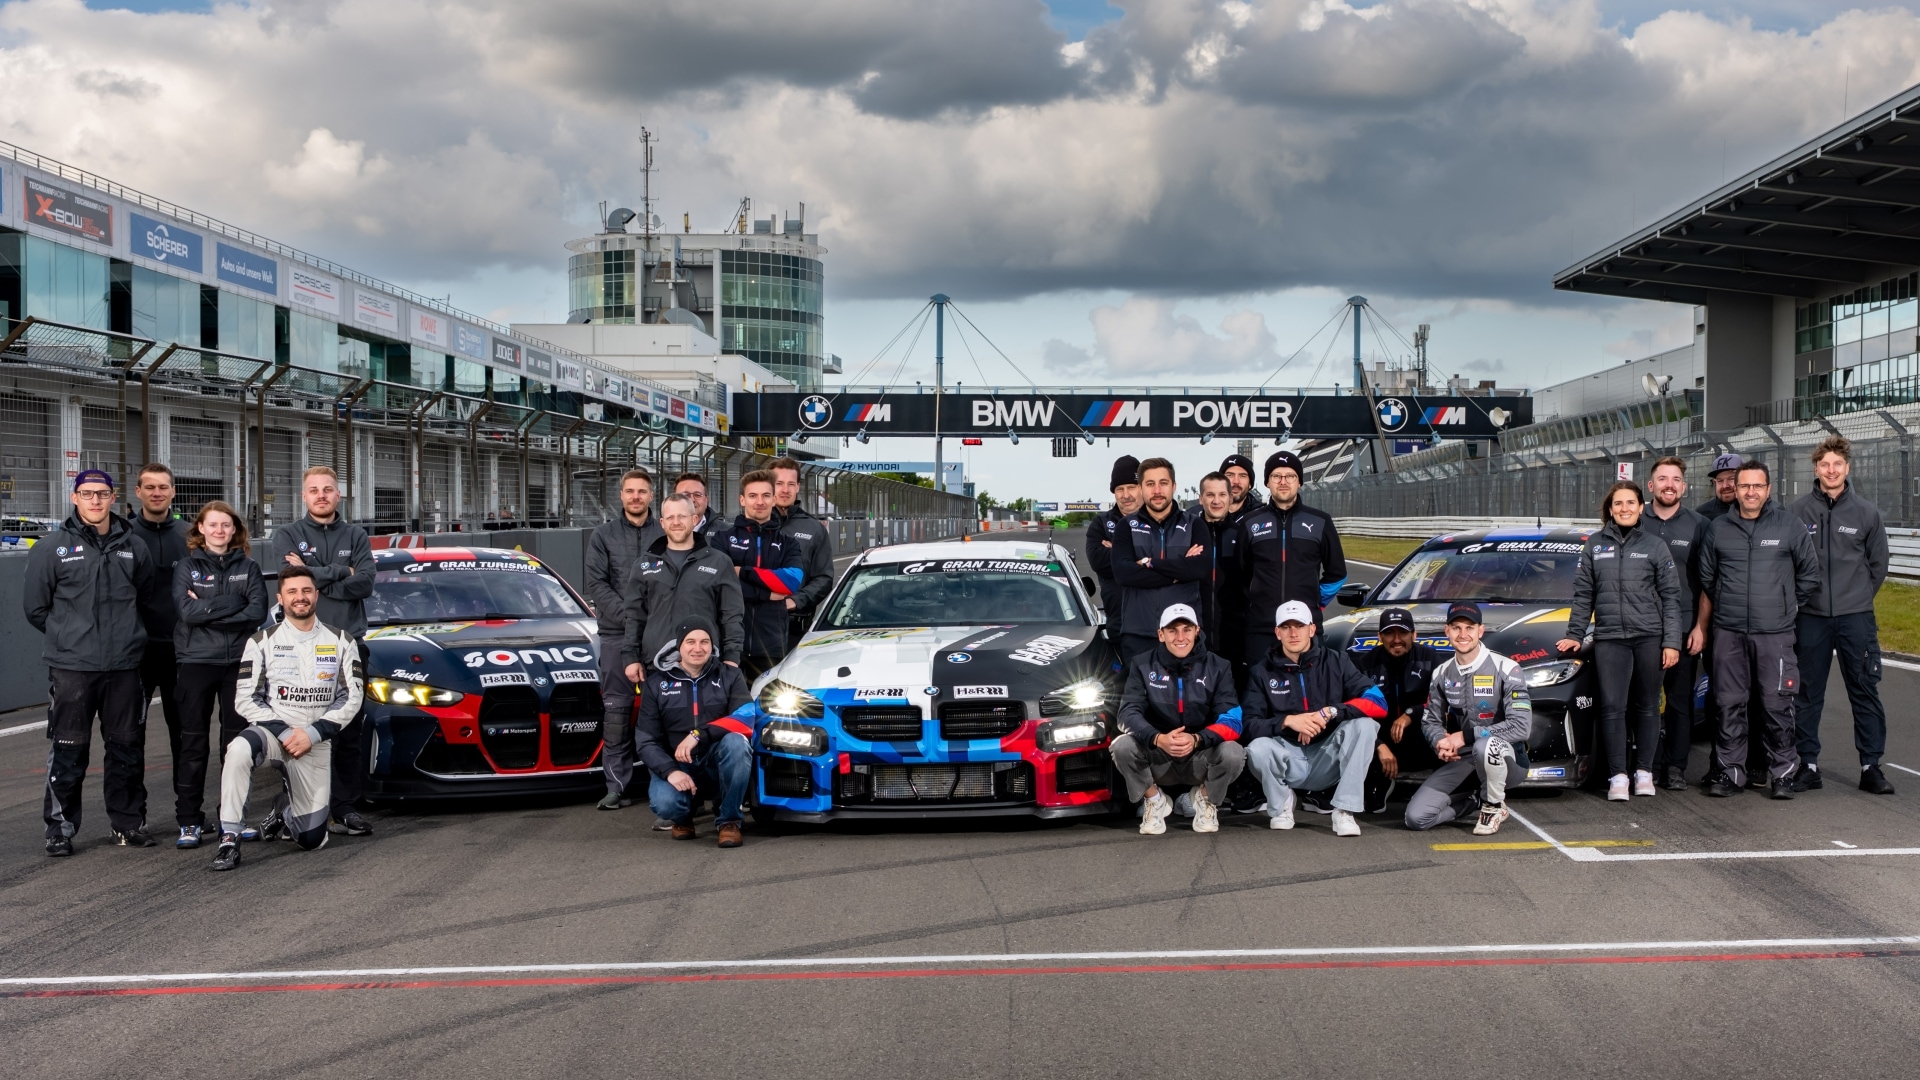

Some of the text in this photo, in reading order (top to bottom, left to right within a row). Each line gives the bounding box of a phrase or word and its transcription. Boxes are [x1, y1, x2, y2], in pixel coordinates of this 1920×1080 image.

[146, 229, 188, 258] SCHERER
[221, 257, 274, 284] Autos sind unsere Welt.
[294, 272, 330, 293] PORSCHE
[359, 294, 390, 312] PORSCHE
[420, 314, 436, 334] ROWE
[804, 397, 828, 407] BMW
[1379, 400, 1404, 410] BMW
[972, 400, 1056, 427] BMW
[1173, 400, 1293, 428] POWER
[1717, 457, 1732, 468] FK
[1539, 542, 1584, 551] TURISM
[479, 562, 536, 571] TURISMO
[988, 561, 1051, 572] TURISMO
[464, 647, 592, 668] sonic
[1511, 648, 1549, 662] Teufel
[392, 669, 430, 682] Teufel
[290, 694, 331, 702] PONTICELLI
